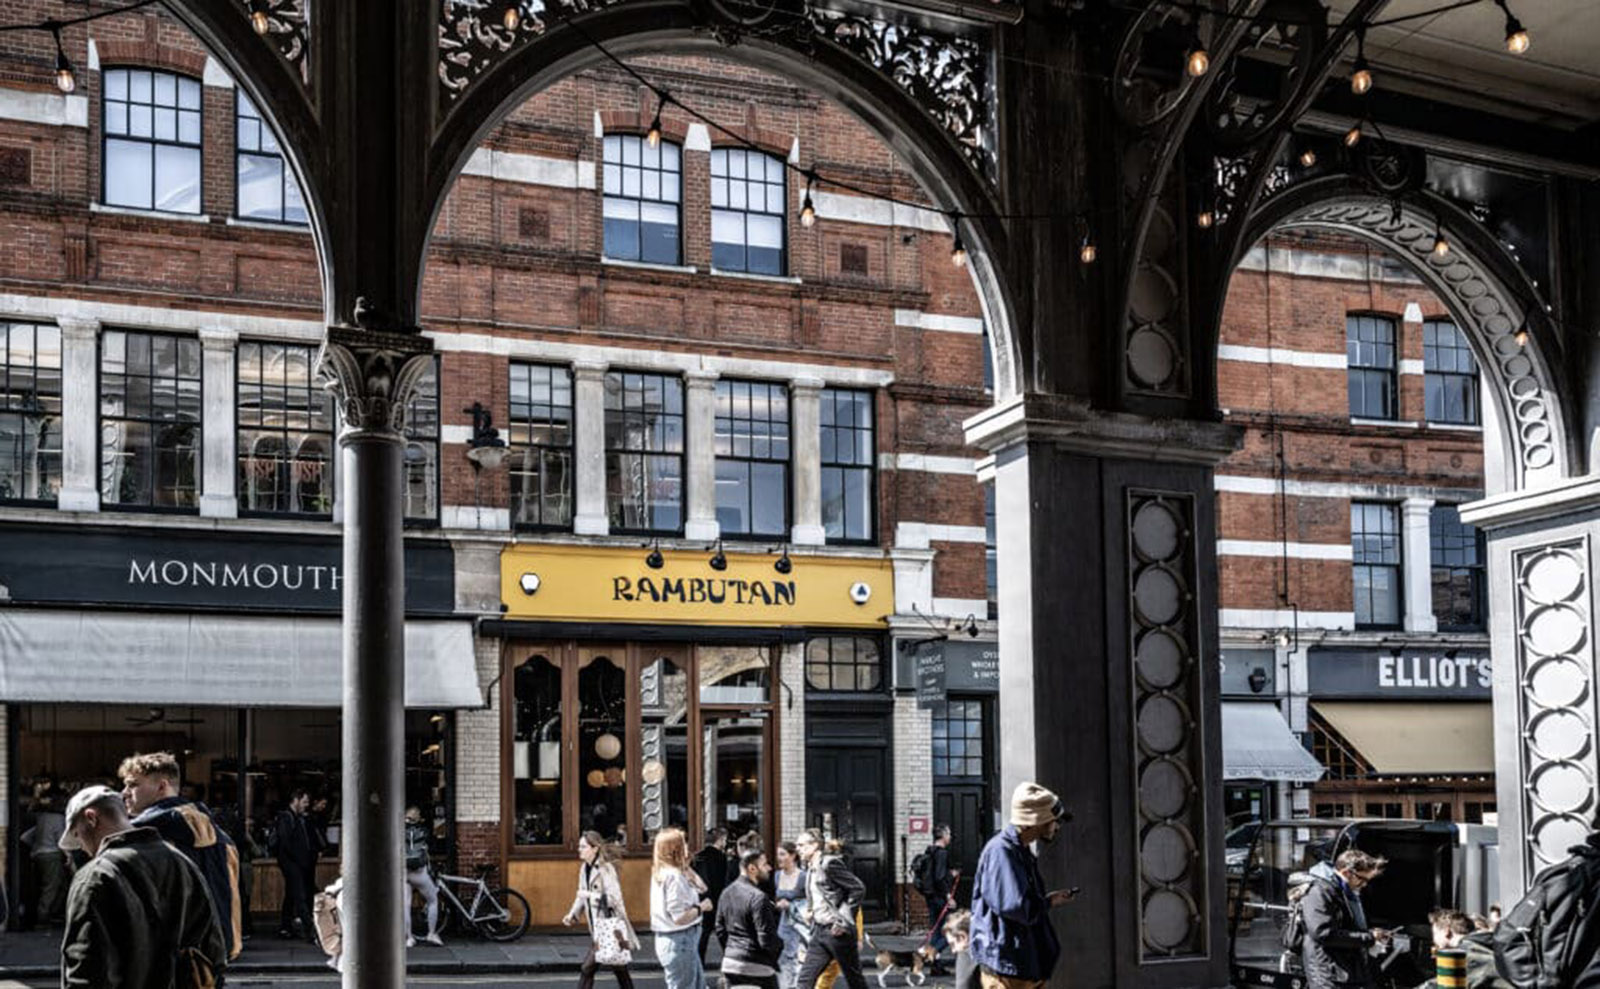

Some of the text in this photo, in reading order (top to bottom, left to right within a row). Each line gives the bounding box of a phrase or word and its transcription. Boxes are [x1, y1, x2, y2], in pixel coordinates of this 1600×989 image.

[128, 559, 343, 590] MONMOUTH
[612, 576, 796, 606] RAMBUTAN
[1379, 657, 1492, 687] ELLIOT'S
